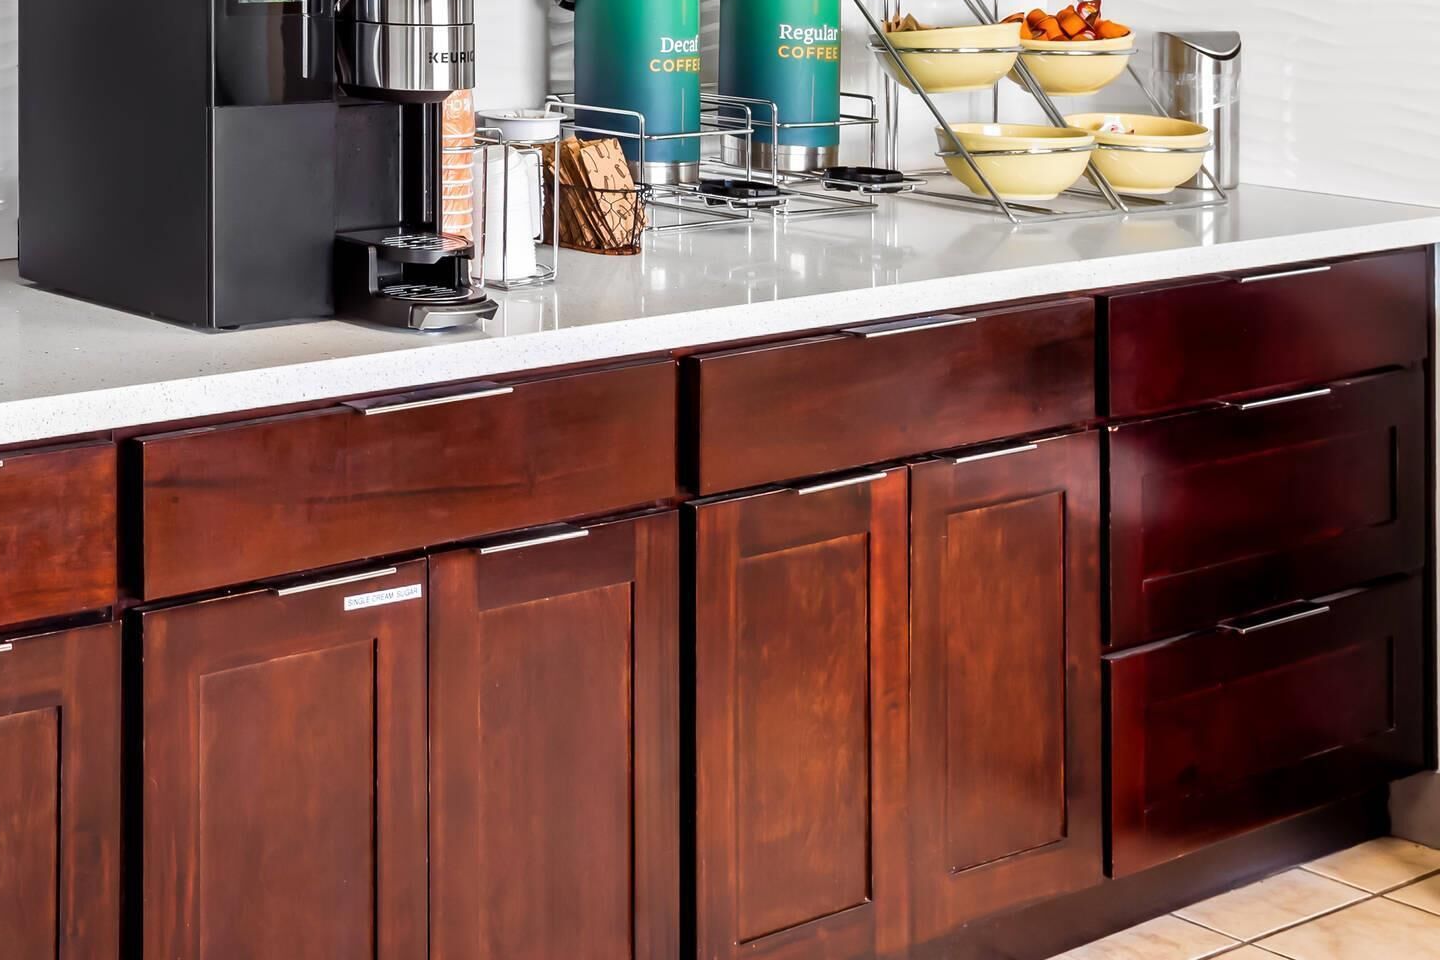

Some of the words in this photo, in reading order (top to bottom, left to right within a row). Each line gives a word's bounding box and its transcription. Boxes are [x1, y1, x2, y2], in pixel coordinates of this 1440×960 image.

[779, 24, 838, 44] Regular
[660, 34, 698, 53] Decaf
[778, 46, 838, 60] COFFEE
[348, 596, 370, 607] SINGLE
